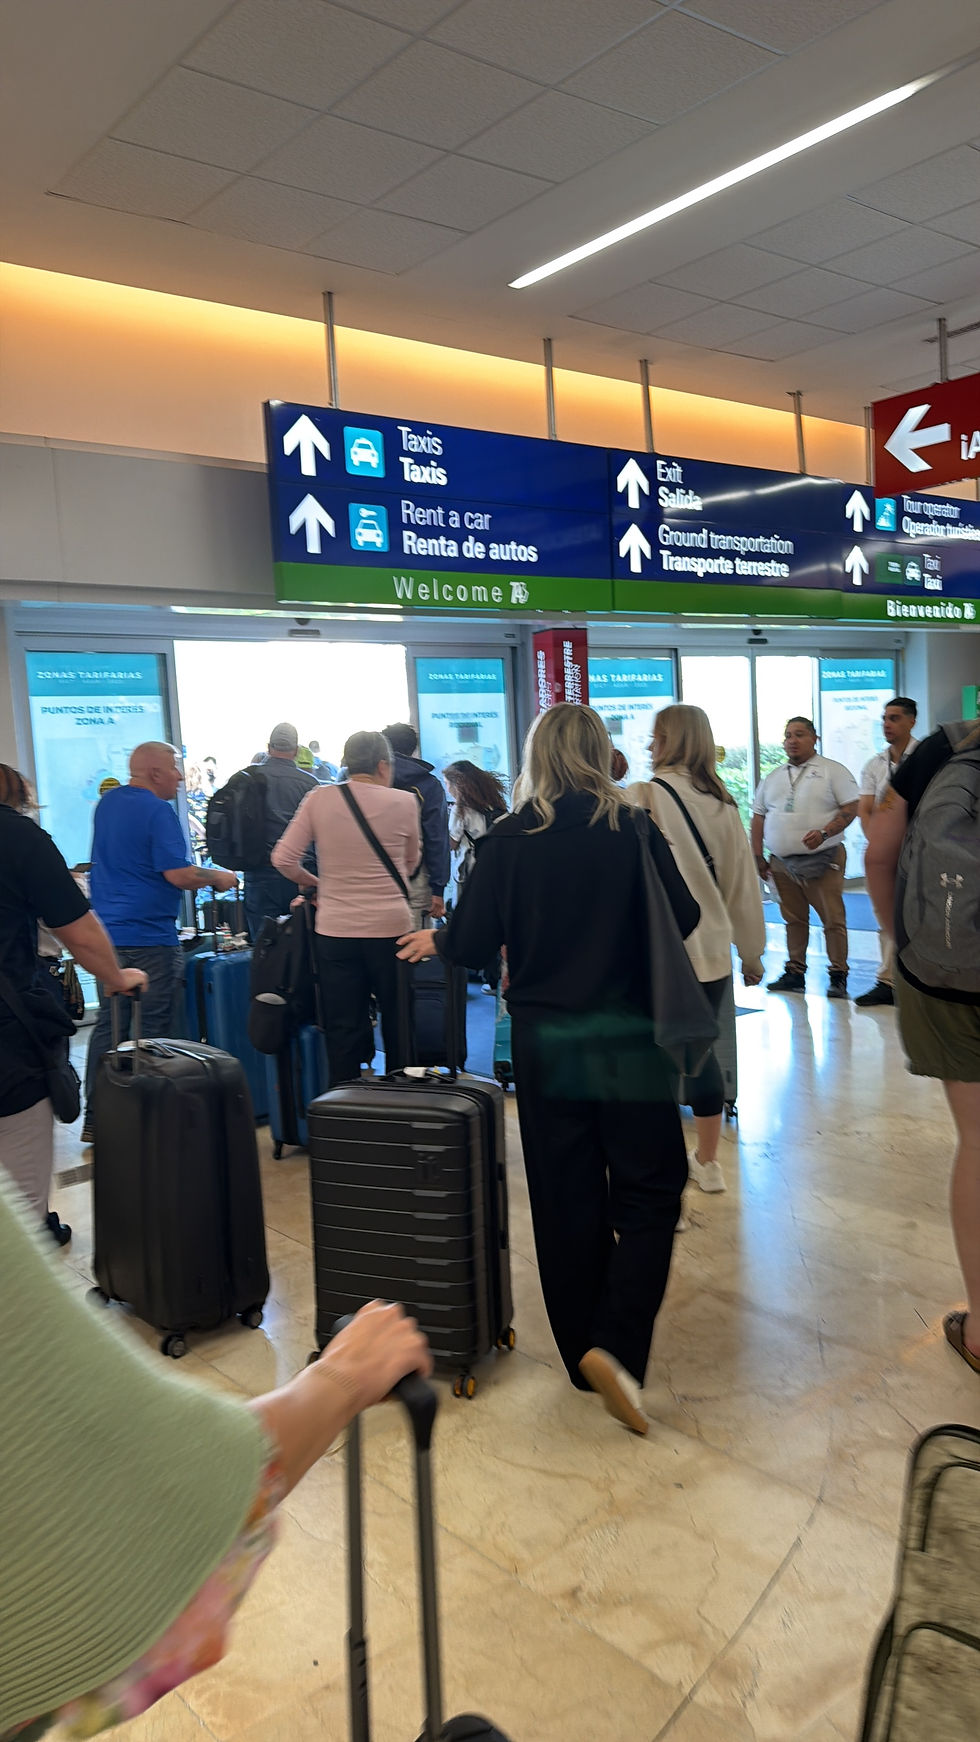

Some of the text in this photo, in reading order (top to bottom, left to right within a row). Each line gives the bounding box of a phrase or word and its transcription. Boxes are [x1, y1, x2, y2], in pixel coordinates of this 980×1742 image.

[397, 426, 443, 455] Taxis
[399, 456, 448, 486] Taxis
[656, 460, 683, 484] Exit
[658, 486, 703, 511] Salida
[901, 495, 961, 519] Tour operator
[401, 500, 492, 530] Rent a car
[902, 516, 946, 538] Operador
[402, 530, 539, 562] Renta de autos
[658, 524, 794, 555] Ground transportation
[659, 550, 790, 578] Transporte terrestre
[393, 576, 503, 602] Welcome
[887, 599, 962, 619] Bienvenido
[36, 671, 144, 680] ZONAS TARIFARIAS
[572, 664, 581, 705] RTATION
[40, 706, 84, 714] PUNTOS
[74, 717, 116, 726] ZONA A
